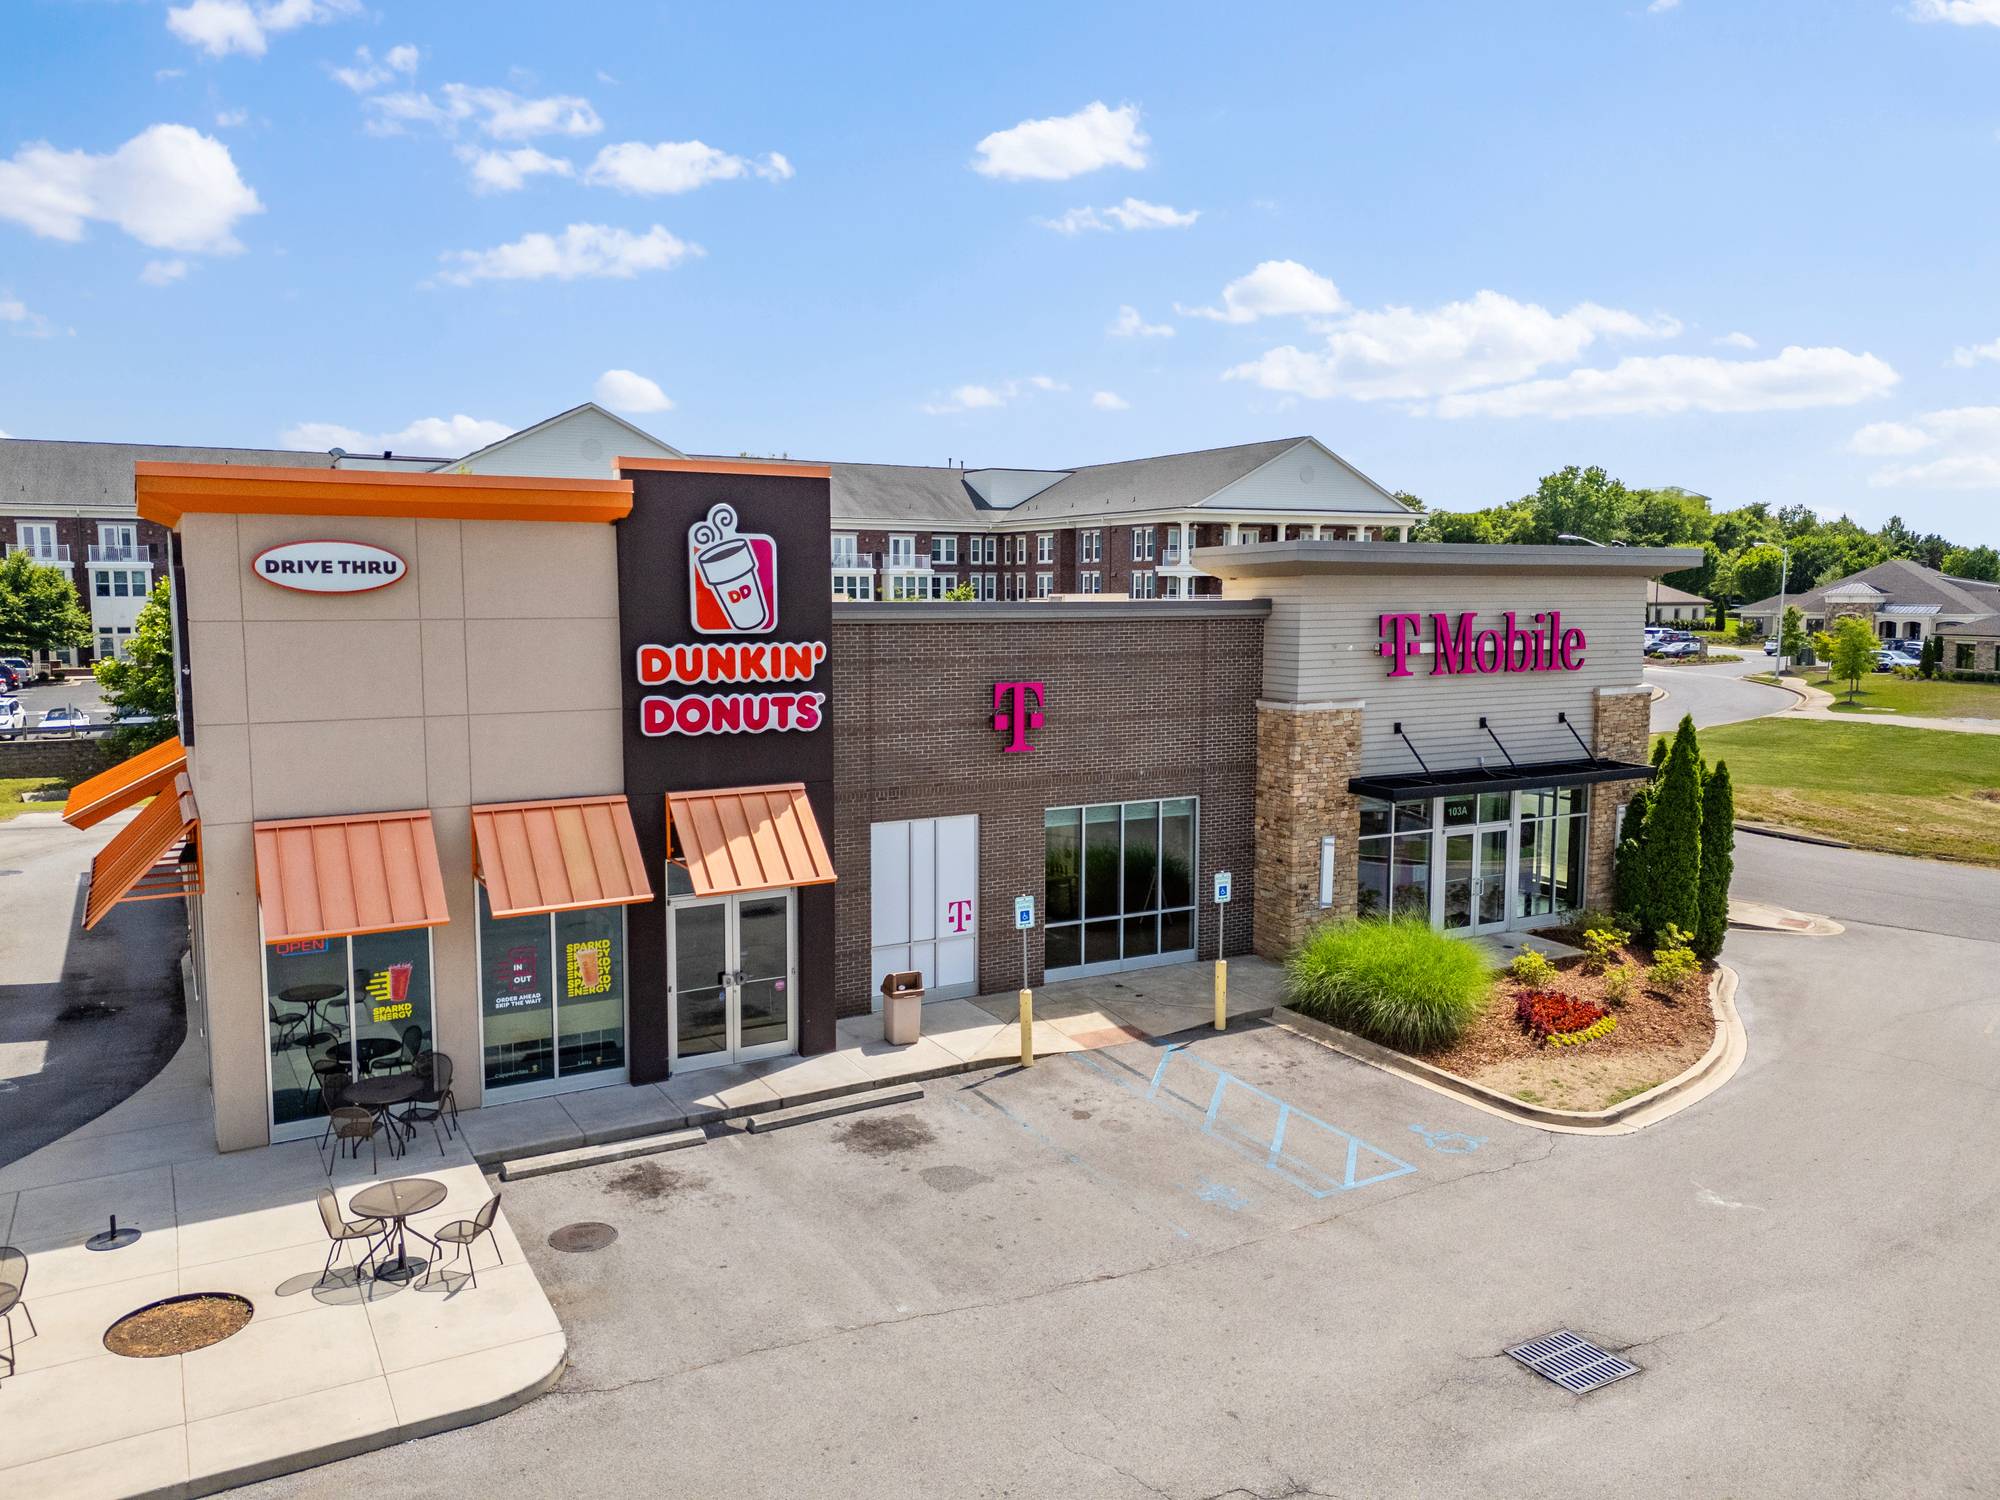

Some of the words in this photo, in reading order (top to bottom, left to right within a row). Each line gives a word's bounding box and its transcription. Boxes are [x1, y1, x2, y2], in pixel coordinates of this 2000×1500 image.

[265, 560, 333, 574] DRIVE
[338, 560, 397, 574] THRU
[727, 584, 752, 604] DD
[640, 644, 825, 683] DUNKIN'
[993, 682, 1045, 753] T
[1447, 806, 1468, 817] 103A
[948, 900, 972, 932] T
[276, 938, 325, 954] OPEN
[566, 939, 610, 953] SPARKD
[513, 963, 523, 972] IN
[513, 975, 532, 984] OUT
[567, 983, 611, 998] ENERGY
[495, 996, 518, 1004] ORDER
[519, 992, 541, 1001] AHEAD
[495, 1001, 510, 1009] SKIP
[525, 997, 542, 1005] WAIT
[373, 1002, 413, 1016] SPARKD
[373, 1009, 413, 1023] ENERGY
